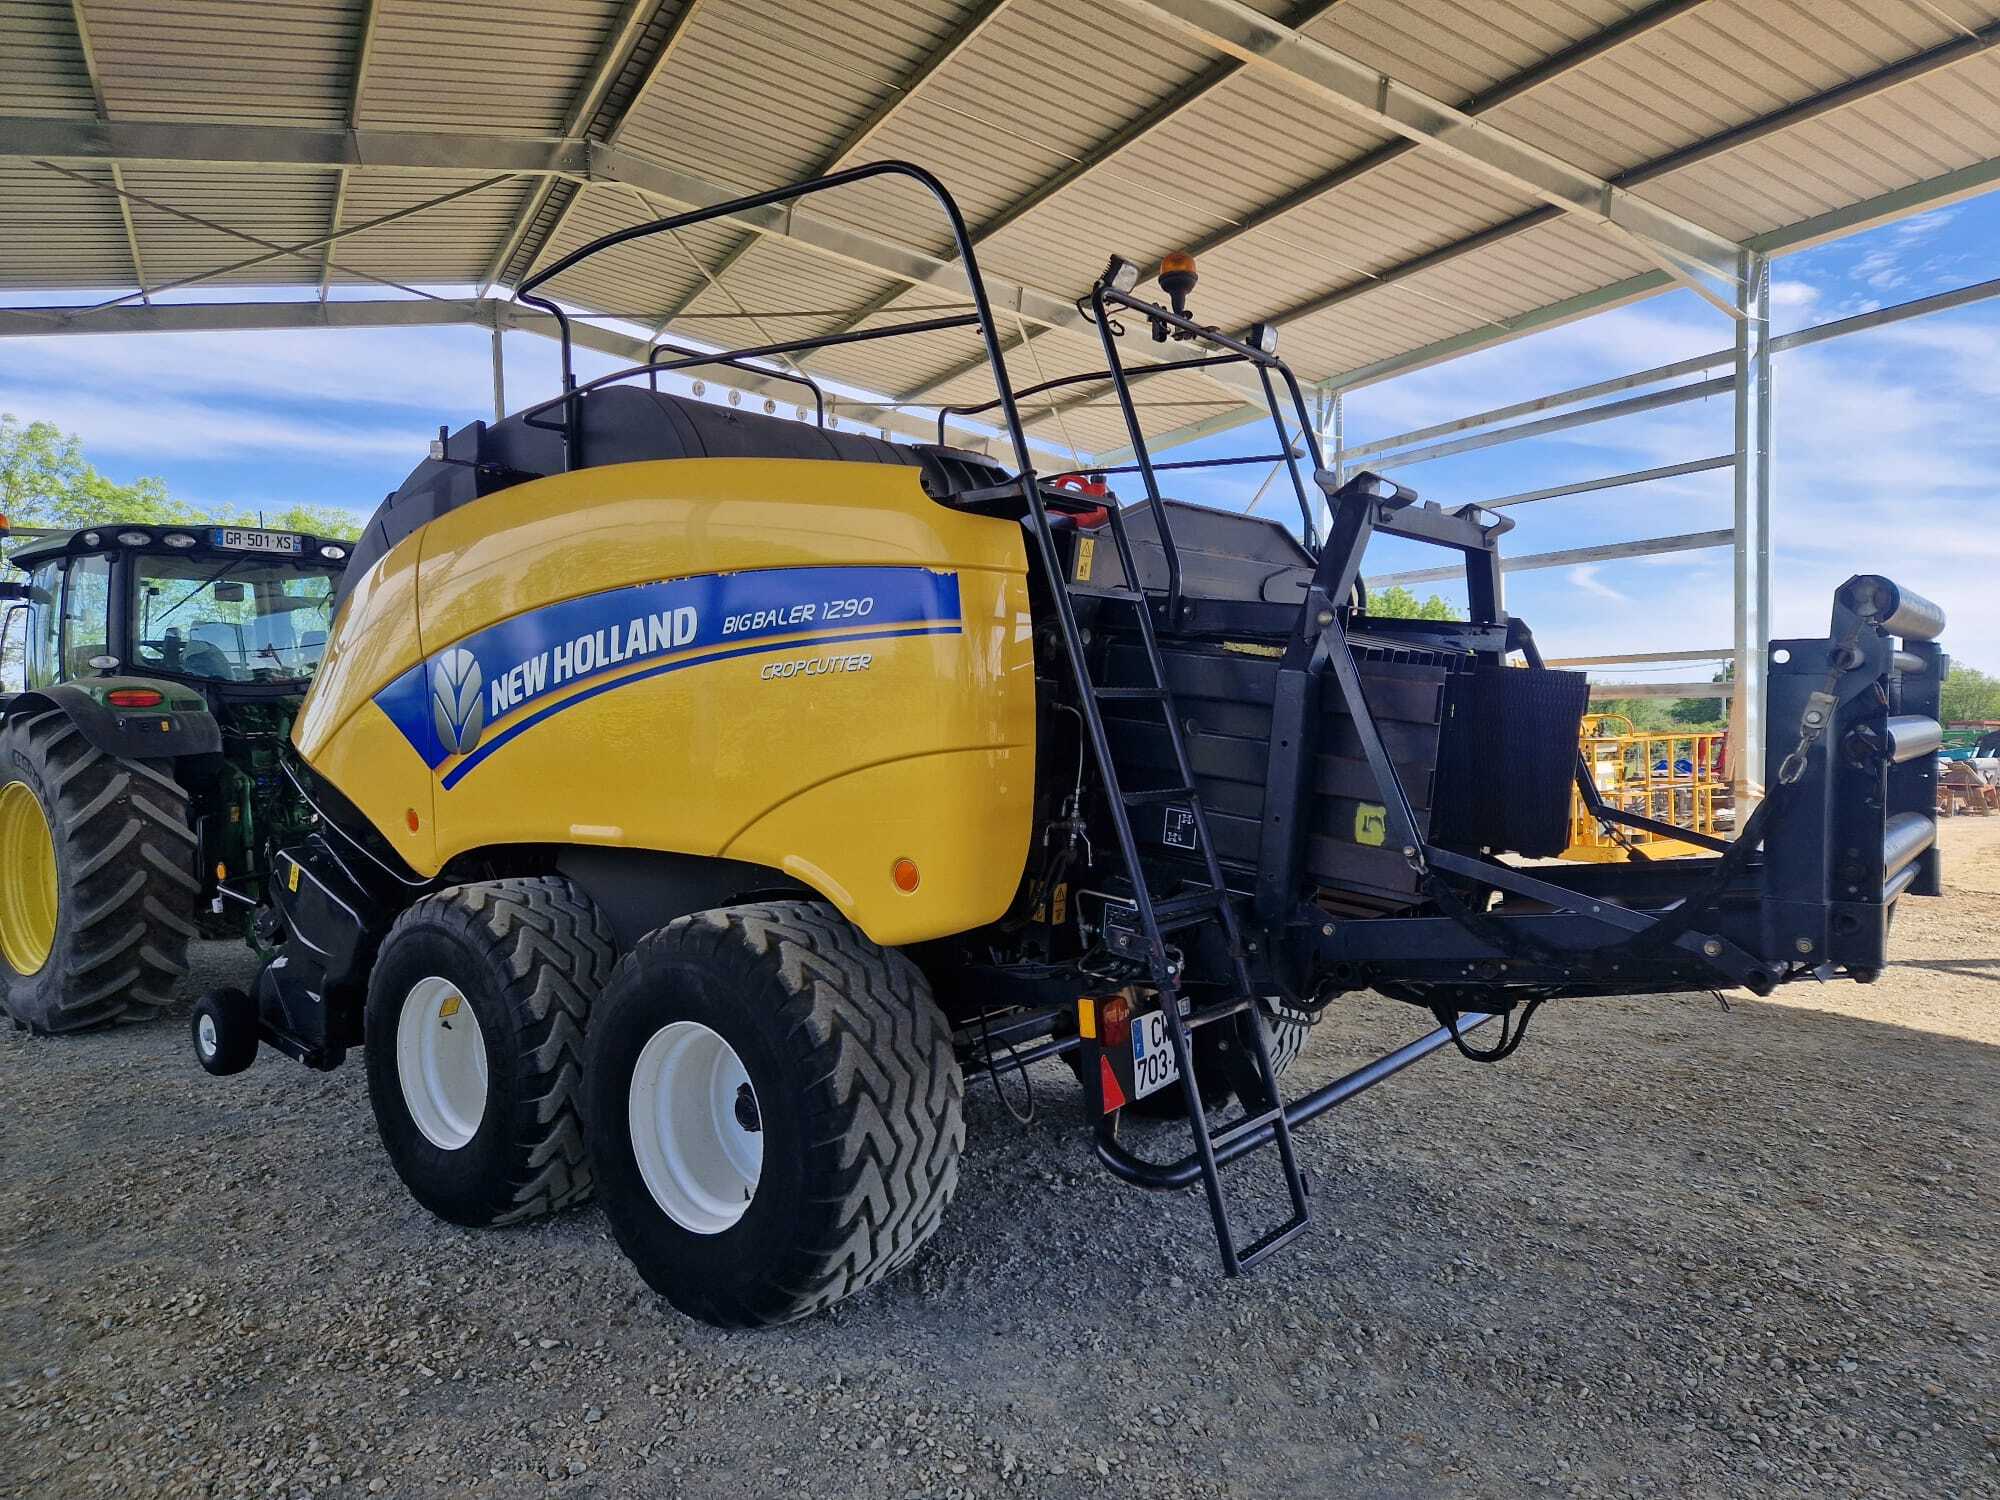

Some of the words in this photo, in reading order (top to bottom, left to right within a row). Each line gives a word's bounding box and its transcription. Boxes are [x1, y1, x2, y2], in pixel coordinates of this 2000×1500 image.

[821, 597, 874, 620] 1290
[491, 652, 548, 717] NEW
[553, 606, 698, 684] HOLLAND
[760, 653, 873, 681] CROPCUTTER
